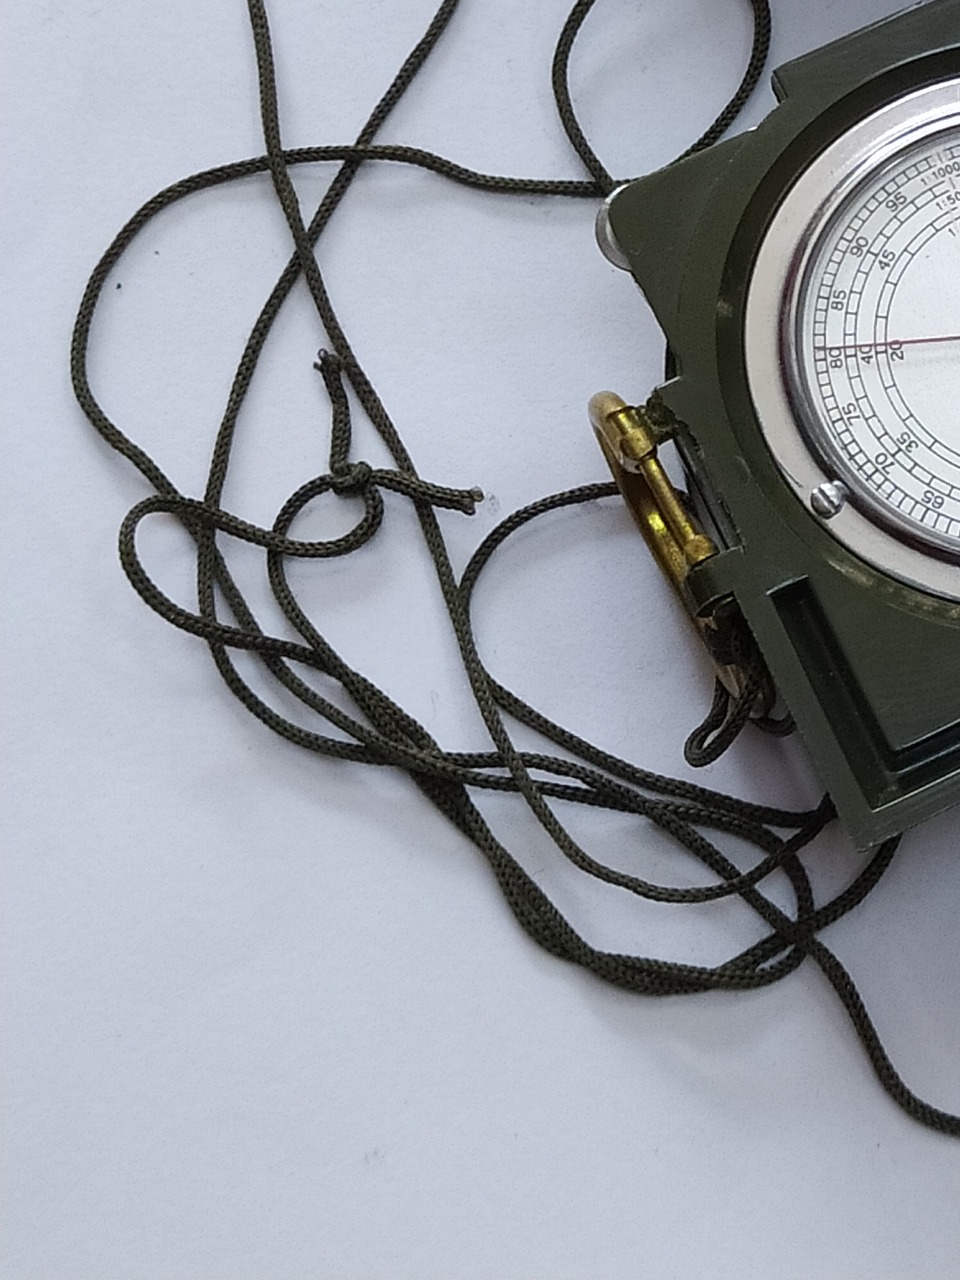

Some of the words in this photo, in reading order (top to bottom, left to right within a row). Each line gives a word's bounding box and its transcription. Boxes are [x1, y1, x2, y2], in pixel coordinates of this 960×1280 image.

[886, 192, 907, 213] 95
[850, 236, 869, 258] 90
[877, 250, 896, 271] 45
[830, 289, 847, 311] 85
[829, 346, 842, 368] 80
[860, 344, 874, 364] 40
[890, 339, 904, 360] 20
[842, 402, 860, 427] 75
[897, 431, 919, 453] 35
[875, 452, 896, 475] 70
[921, 489, 945, 509] 65
